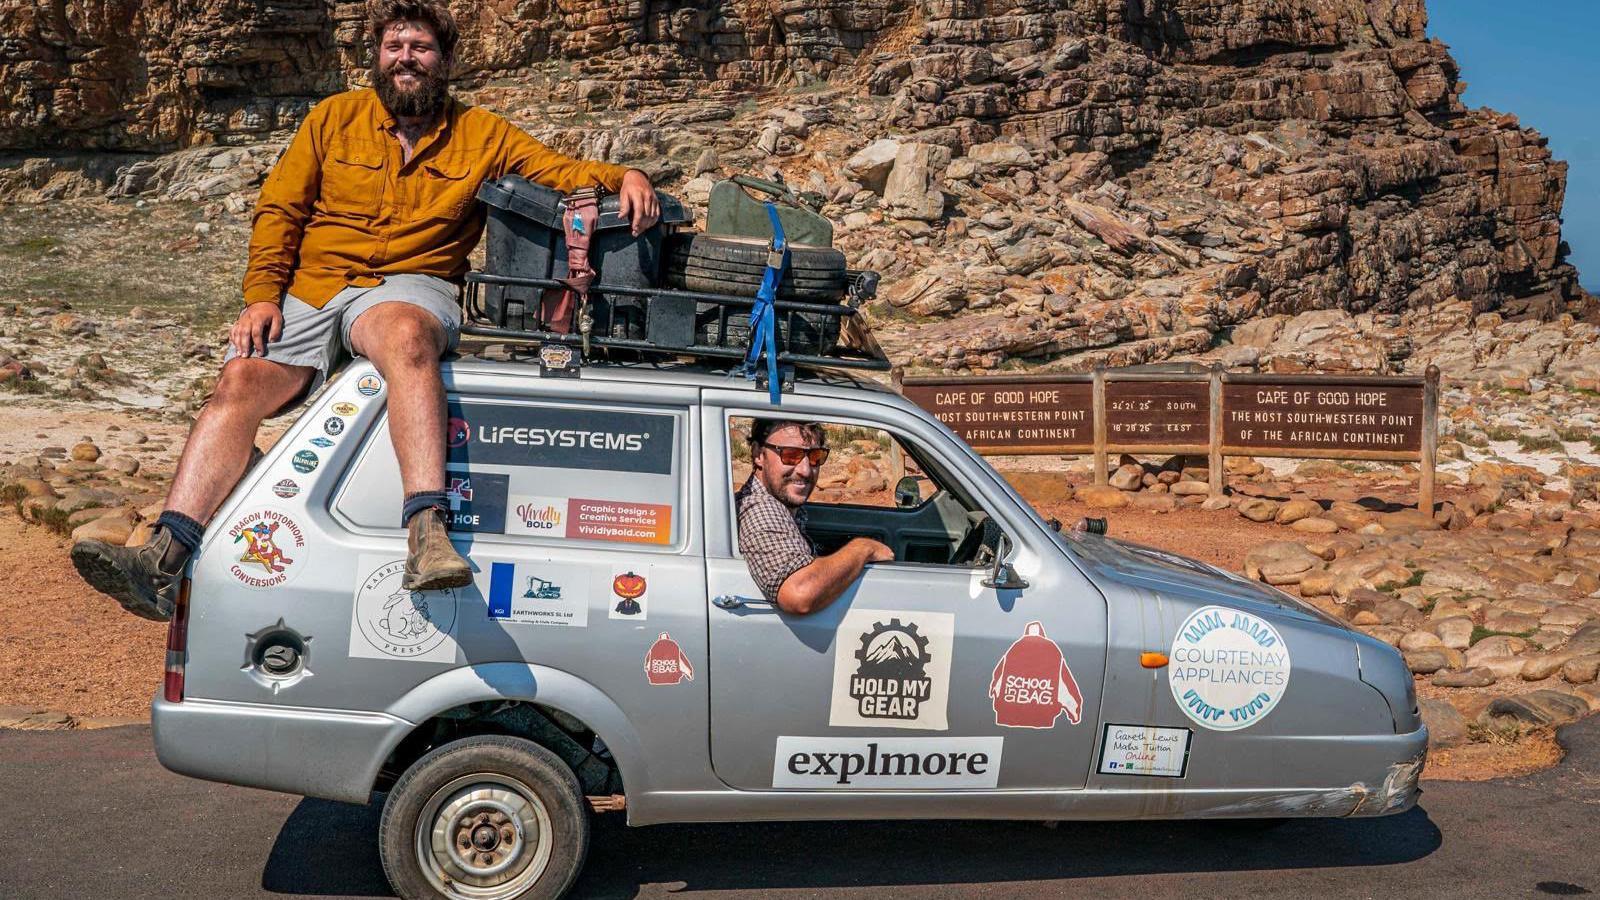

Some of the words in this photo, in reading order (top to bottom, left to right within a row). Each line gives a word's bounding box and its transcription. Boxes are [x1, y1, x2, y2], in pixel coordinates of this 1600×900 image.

[936, 392, 966, 405] CAPE
[971, 392, 985, 405] OF
[994, 391, 1025, 404] GOOD
[1029, 391, 1060, 403] HOPE
[1257, 391, 1288, 404] CAPE
[1294, 392, 1310, 405] OF
[1317, 392, 1350, 405] GOOD
[1355, 392, 1387, 406] HOPE
[1166, 402, 1196, 410] SOUTH
[934, 412, 961, 422] MOST
[965, 411, 1051, 421] SOUTH-WESTERN
[1054, 410, 1085, 421] POINT
[1231, 411, 1250, 422] THE
[1255, 412, 1282, 423] MOST
[1287, 413, 1375, 425] SOUTH-WESTERN
[1381, 415, 1414, 426] POINT
[966, 429, 1011, 440] AFRICAN
[1018, 428, 1076, 439] CONTINENT
[1167, 424, 1192, 432] EAST
[1240, 429, 1252, 440] OF
[1263, 430, 1282, 440] THE
[1290, 431, 1338, 442] AFRICAN
[1343, 432, 1405, 444] CONTINENT
[516, 503, 561, 526] Vividly
[580, 504, 615, 514] Graphic
[617, 505, 648, 516] Design
[453, 513, 480, 525] HOE
[526, 520, 553, 529] BOLD
[580, 513, 617, 522] Creative
[620, 514, 657, 525] Services
[228, 511, 261, 537] DRAGON
[264, 510, 305, 548] MOTORHOME
[579, 526, 657, 538] VividlyBold.com
[230, 564, 287, 587] CONVERSIONS
[384, 643, 422, 653] PRESS
[652, 659, 677, 667] SCHOOL
[1174, 647, 1286, 667] COURTENAY
[1006, 675, 1055, 690] SCHOOL
[1172, 667, 1285, 686] APPLIANCES
[853, 677, 899, 697] HOLD
[901, 679, 930, 698] MY
[861, 695, 917, 717] GEAR
[1115, 729, 1147, 741] Gareth
[1152, 732, 1179, 742] Lewis
[1142, 743, 1172, 752] Tuition
[1125, 752, 1156, 761] Online
[787, 743, 989, 785] explmore
